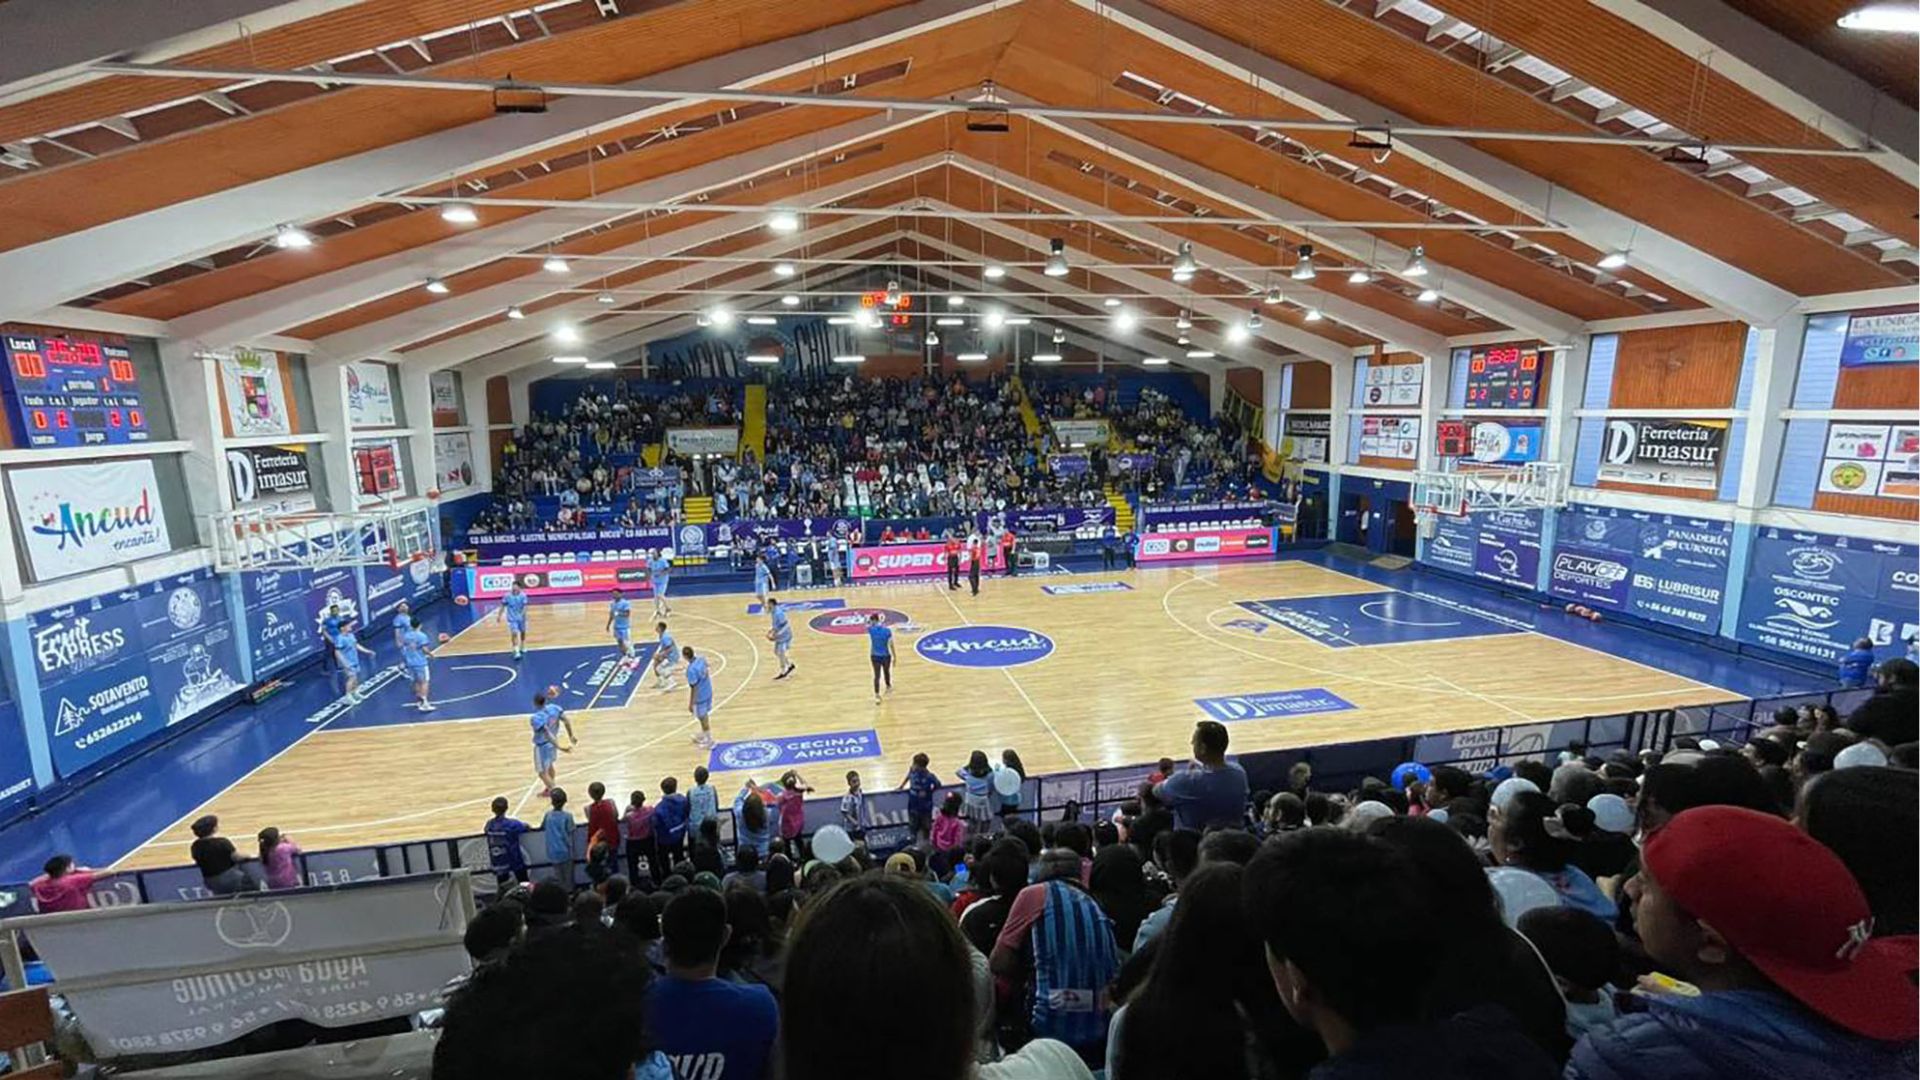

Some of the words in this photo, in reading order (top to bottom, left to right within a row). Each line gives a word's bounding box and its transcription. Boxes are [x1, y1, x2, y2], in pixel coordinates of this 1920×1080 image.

[15, 353, 46, 377] 00
[1641, 425, 1708, 442] Ferretería
[254, 452, 298, 470] Ferretería
[52, 484, 155, 550] Ancud
[495, 533, 516, 543] ANCUD
[547, 531, 597, 541] MUNICIPALIDAD
[600, 529, 621, 539] ANCUD
[649, 527, 669, 537] ANCUD
[1667, 529, 1729, 547] PANADERÍA
[878, 554, 934, 569] SUPER
[1554, 571, 1611, 589] DEPORTES
[1658, 578, 1720, 600] LUBRISUR
[1774, 586, 1840, 606] OSCONTEC
[42, 627, 125, 672] EXPRESS
[944, 633, 1044, 654] Ancud
[89, 676, 149, 710] SOTAVENTO
[787, 736, 869, 750] CECINAS
[794, 745, 864, 759] ANCUD
